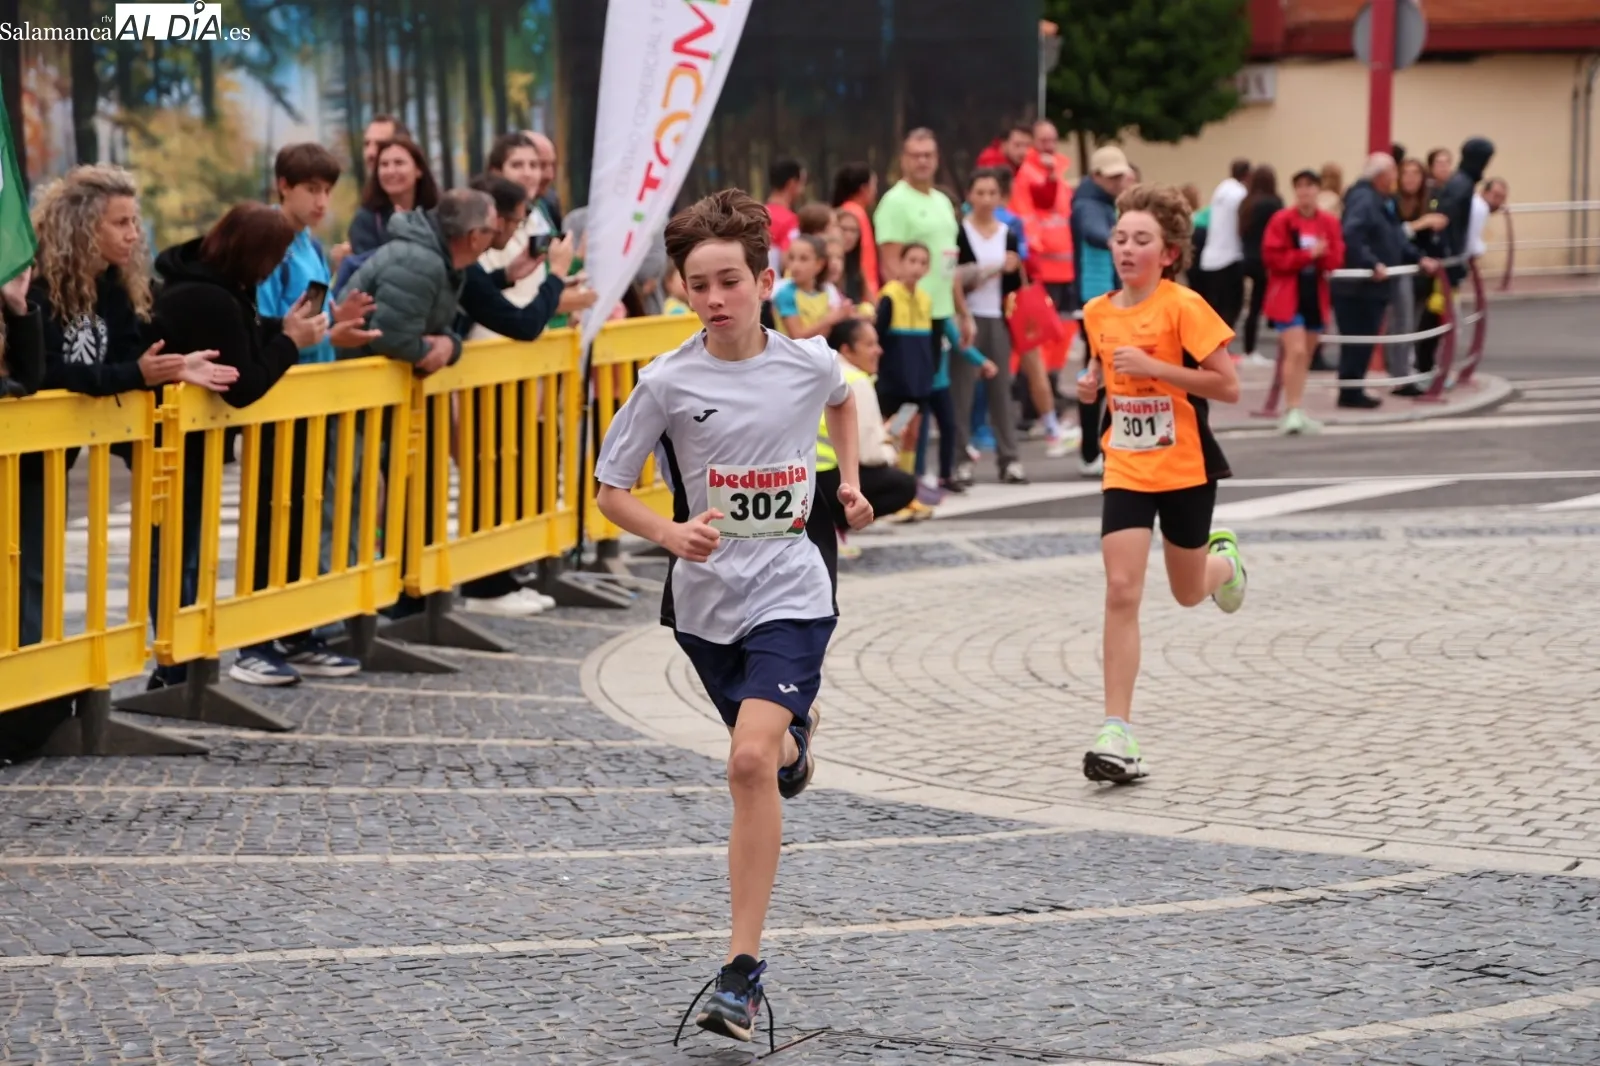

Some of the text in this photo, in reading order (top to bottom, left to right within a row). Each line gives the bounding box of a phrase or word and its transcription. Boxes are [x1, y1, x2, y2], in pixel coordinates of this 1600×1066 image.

[1122, 416, 1156, 438] 301
[709, 465, 807, 489] bedunia
[729, 490, 793, 521] 302
